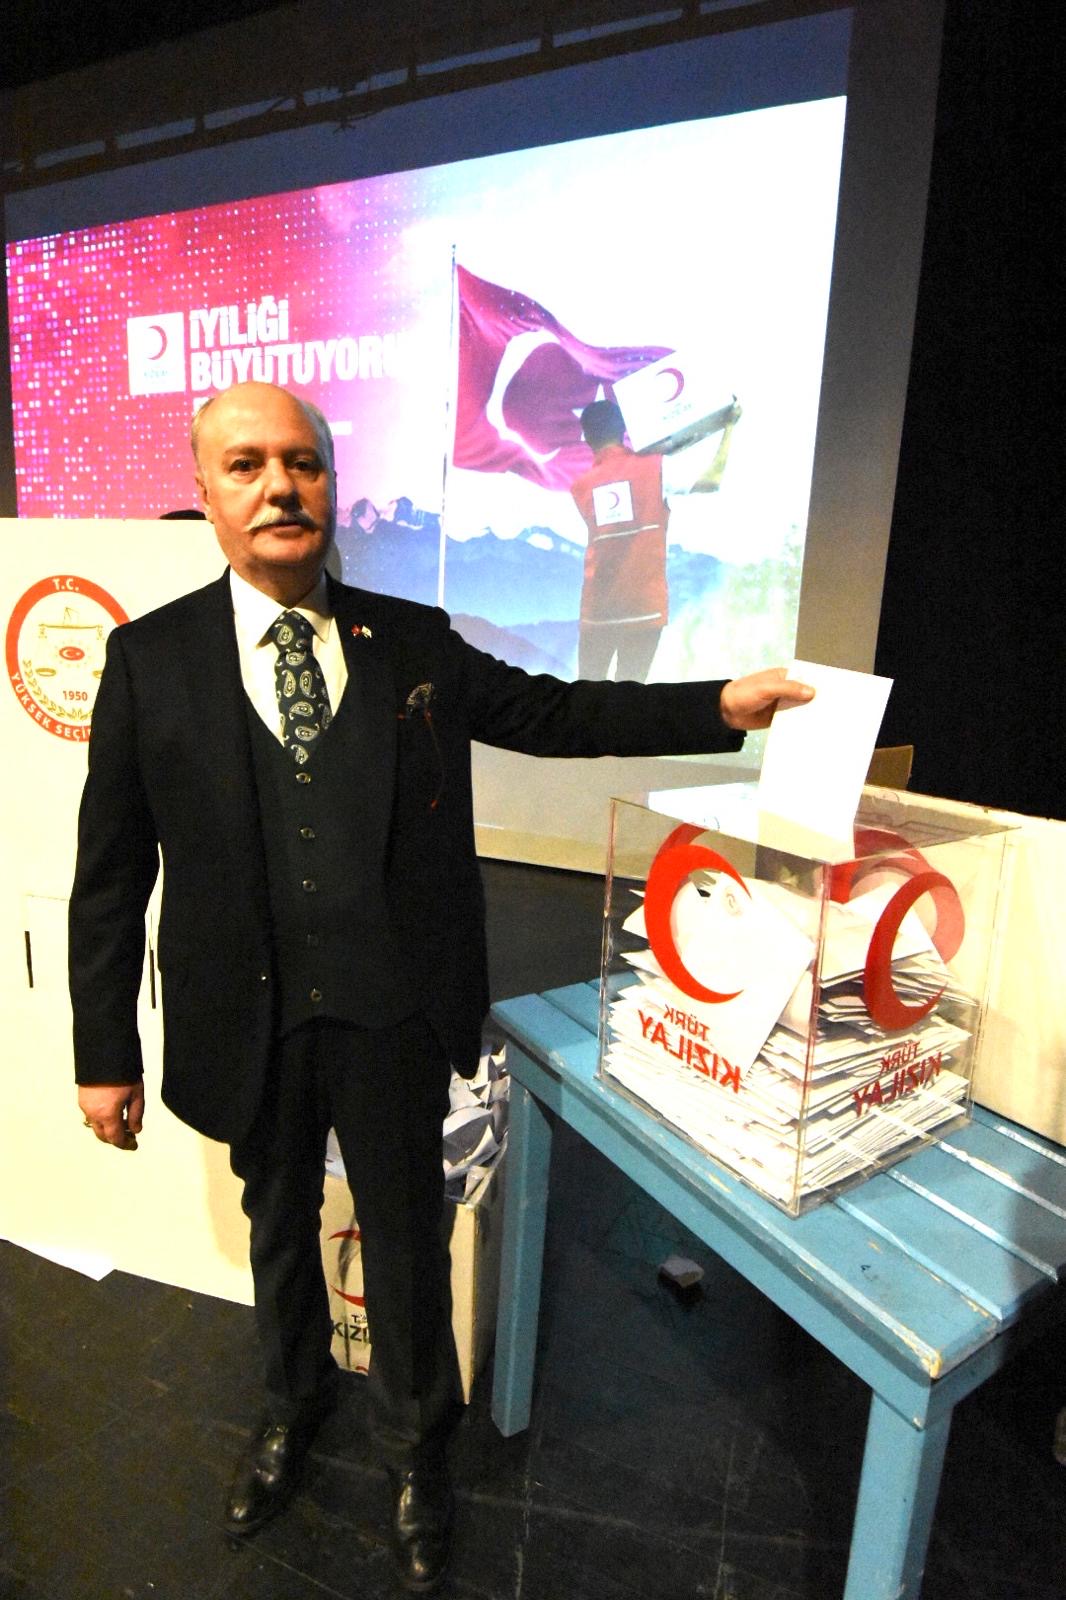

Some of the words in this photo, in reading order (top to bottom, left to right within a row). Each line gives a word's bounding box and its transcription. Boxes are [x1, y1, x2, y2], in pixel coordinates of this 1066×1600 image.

[52, 578, 79, 591] T.C.
[10, 673, 50, 728] YÜKSEK
[62, 690, 88, 701] 1950
[331, 1320, 370, 1343] KIZI
